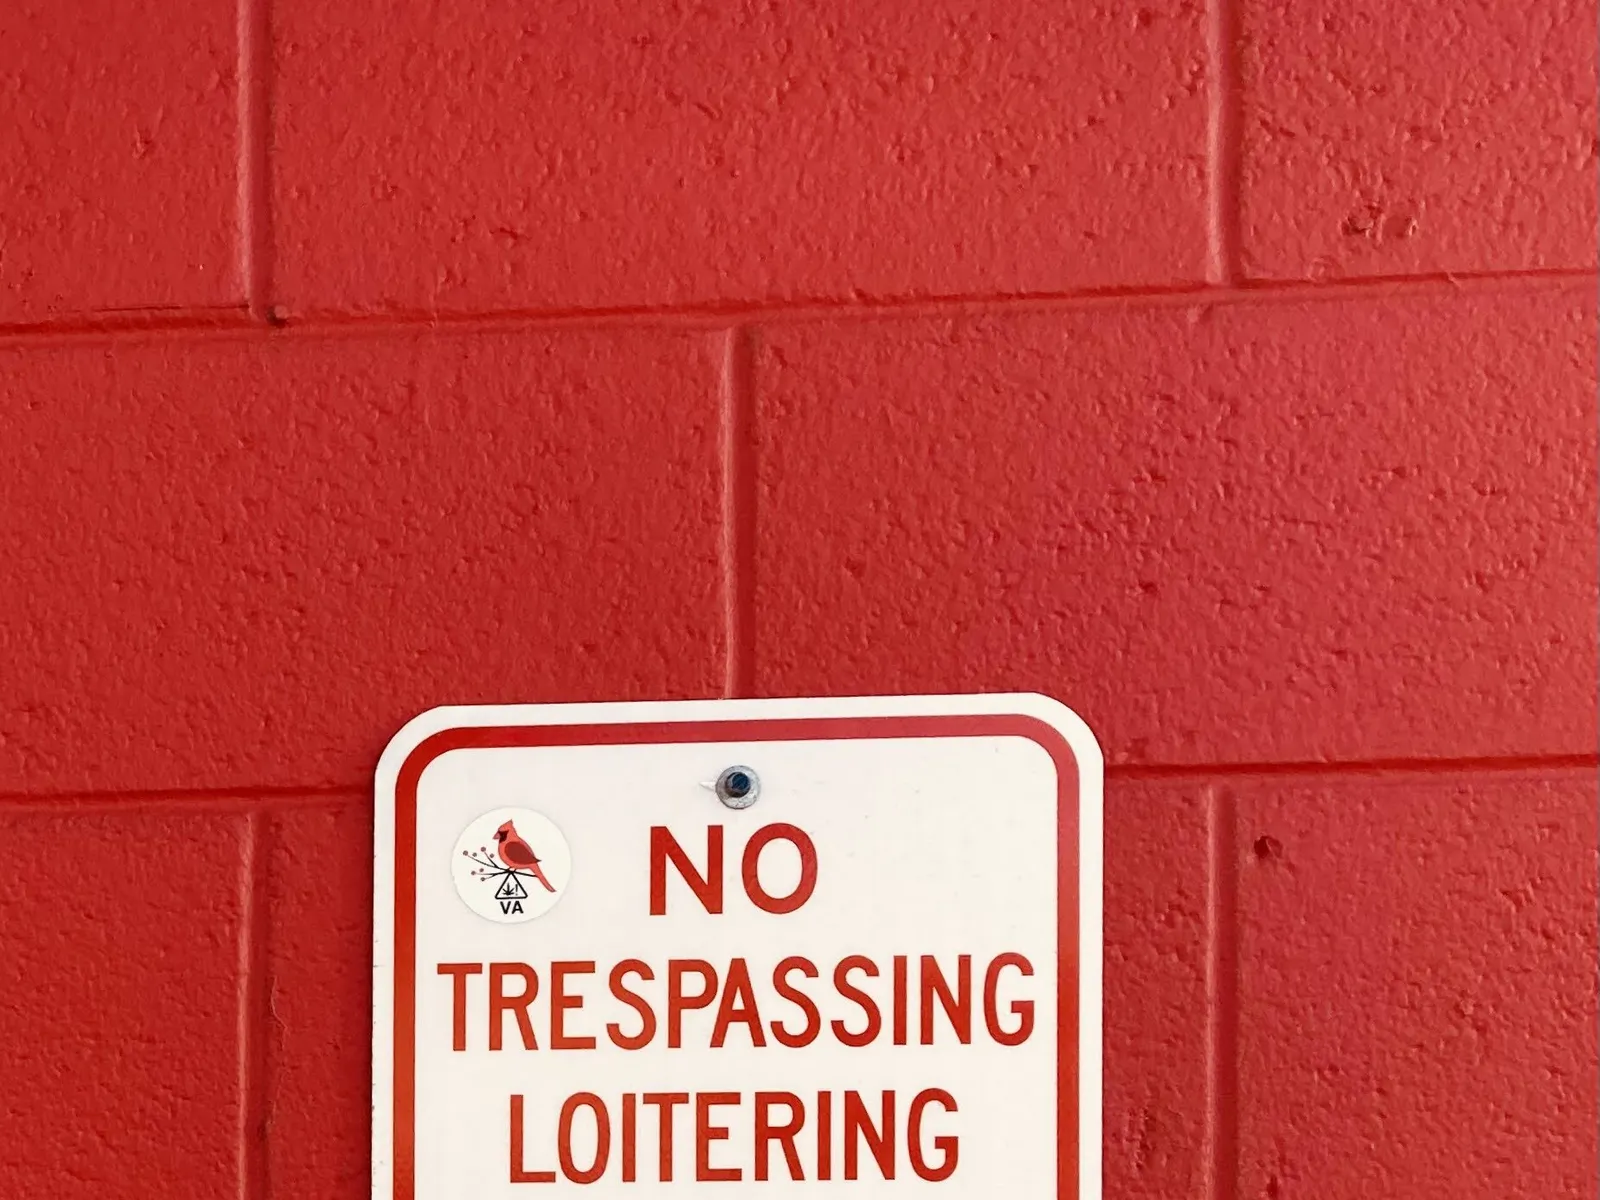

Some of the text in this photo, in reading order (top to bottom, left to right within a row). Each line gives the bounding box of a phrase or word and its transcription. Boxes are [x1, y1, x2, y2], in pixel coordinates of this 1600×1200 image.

[499, 900, 525, 915] VA
[650, 823, 818, 915] NO
[437, 952, 1034, 1051] TRESPASSING
[510, 1088, 958, 1184] LOITERING
